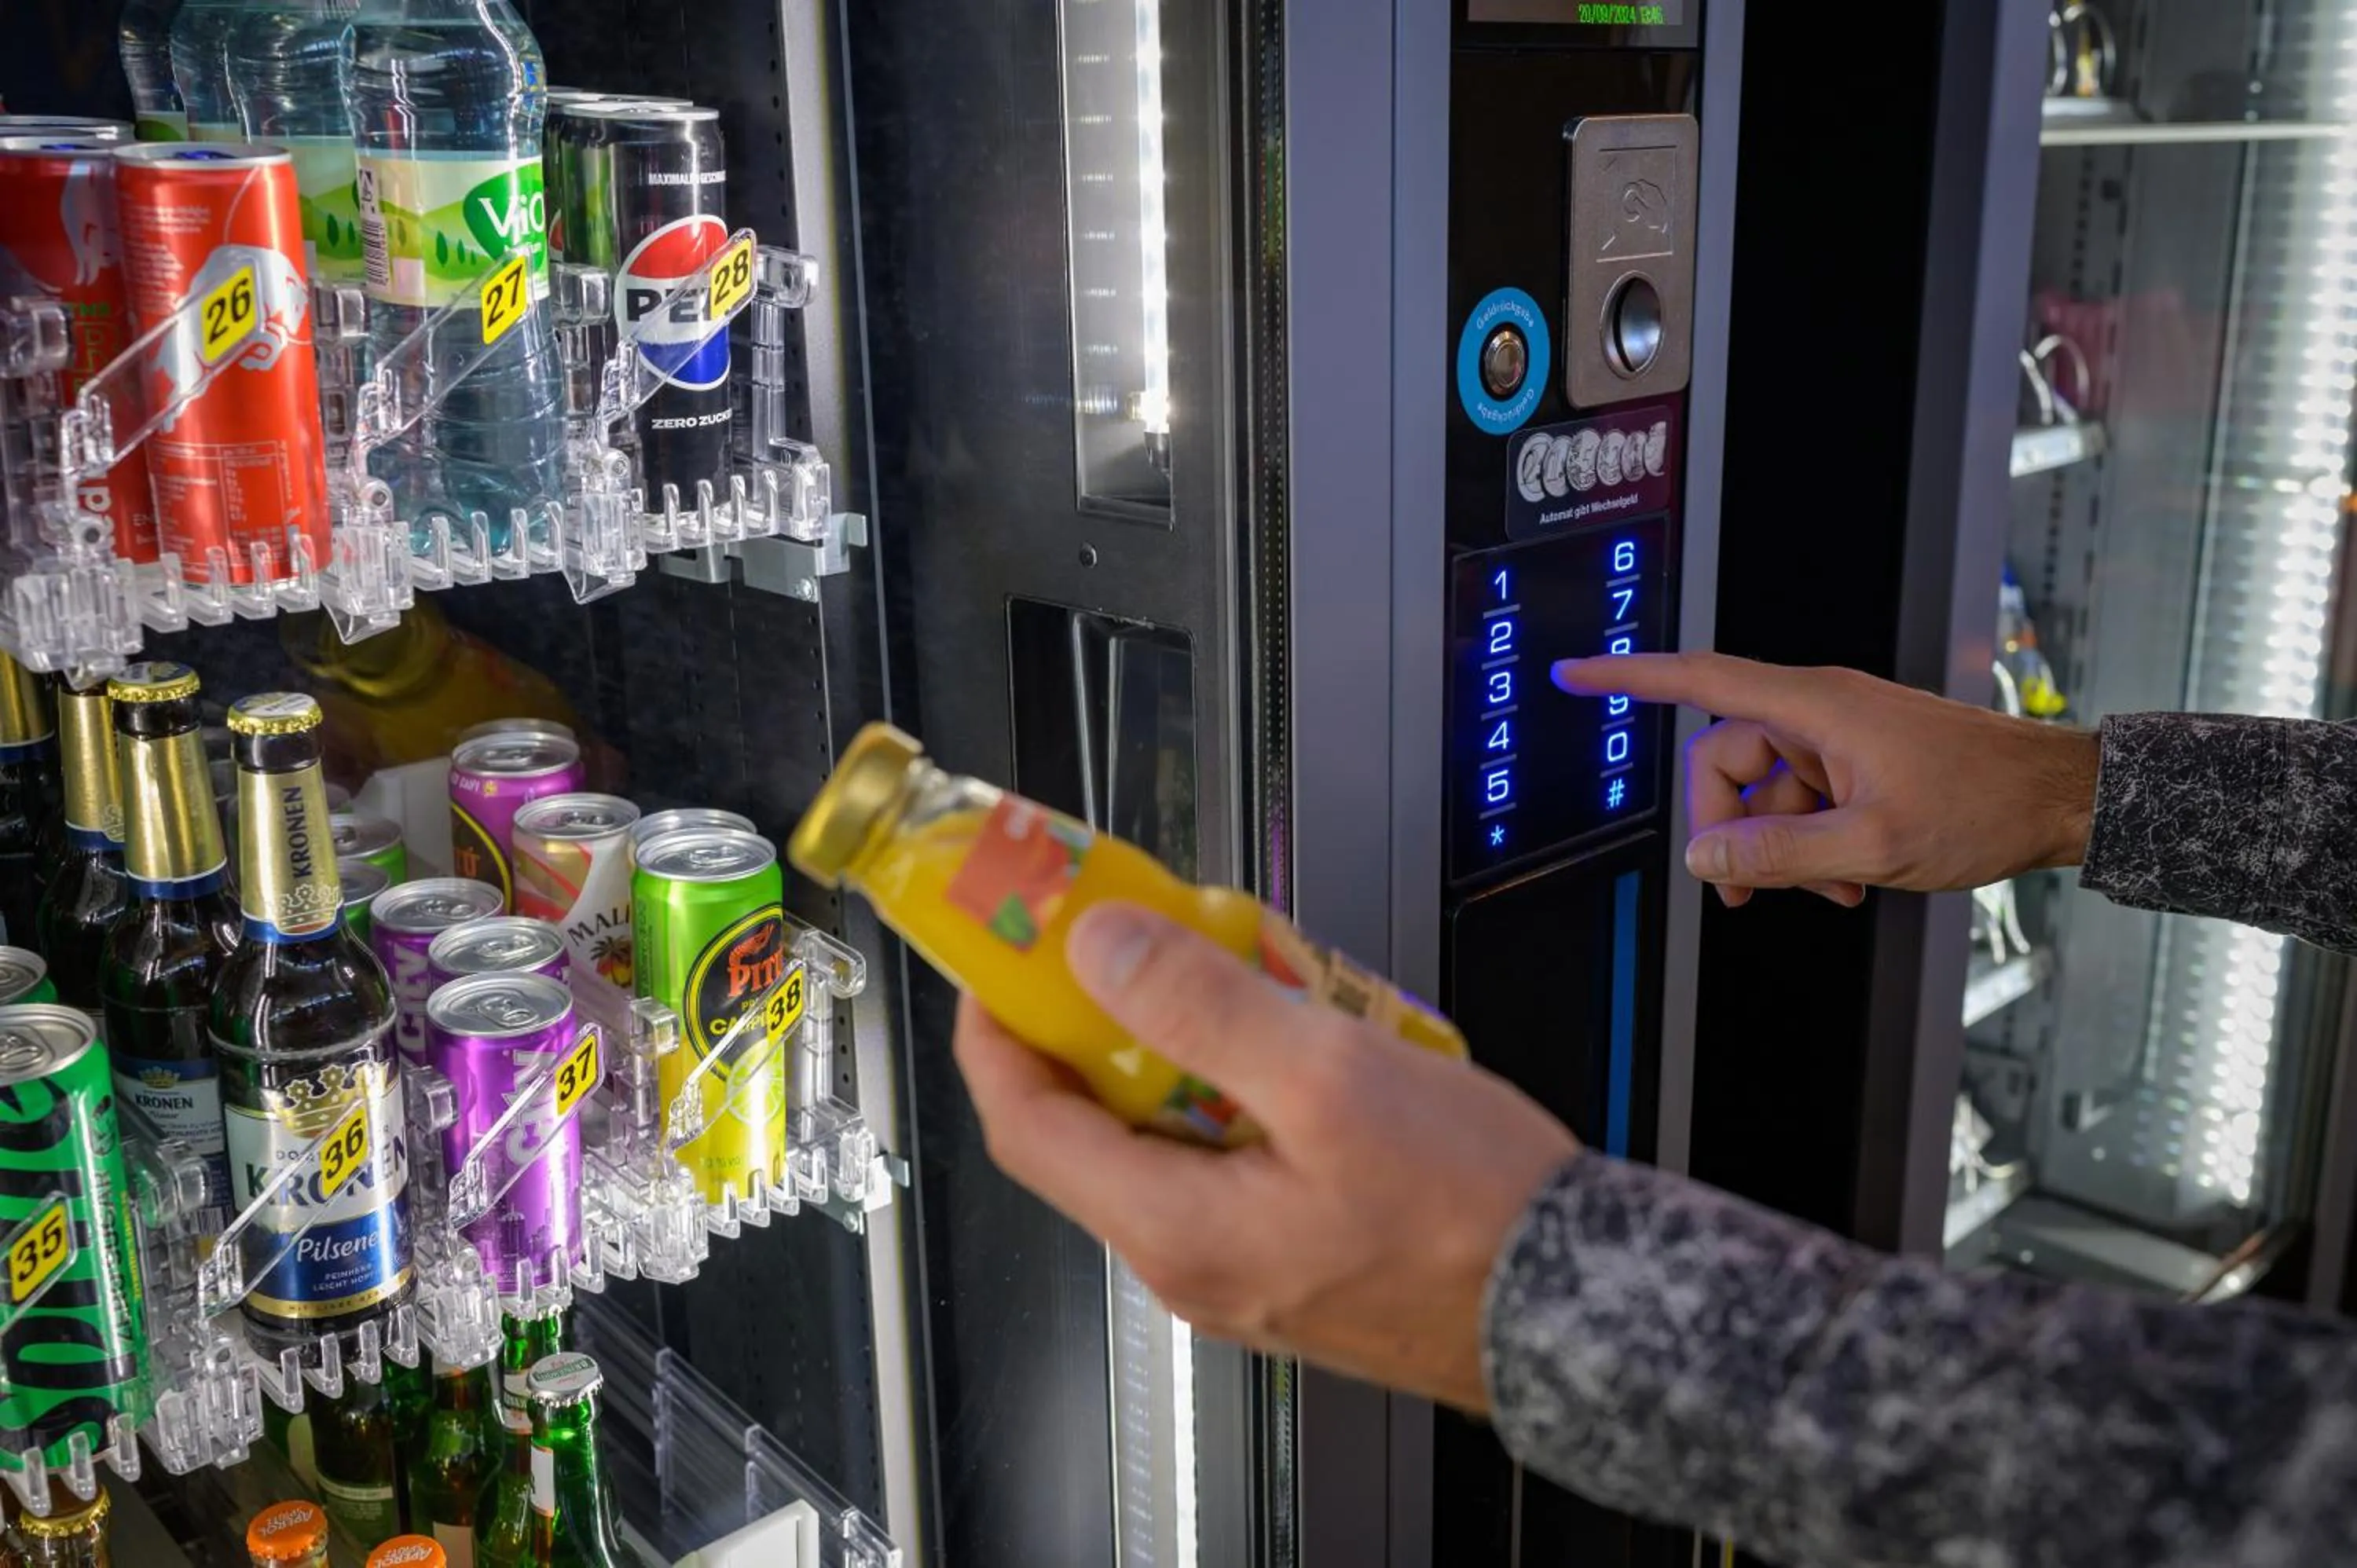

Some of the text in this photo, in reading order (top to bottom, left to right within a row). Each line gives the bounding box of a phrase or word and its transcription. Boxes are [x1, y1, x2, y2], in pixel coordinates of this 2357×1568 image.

[714, 249, 749, 306] 28
[206, 277, 252, 343] 26
[486, 263, 523, 328] 27
[651, 417, 698, 430] ZERO
[1539, 493, 1638, 525] Automat gibt Wechselgeld
[1614, 541, 1634, 572] 6
[1494, 570, 1507, 599] 1
[1612, 589, 1633, 620] 7
[1490, 621, 1512, 653] 2
[1489, 671, 1511, 703] 3
[1487, 720, 1509, 750] 4
[1607, 731, 1627, 762] 0
[1486, 769, 1508, 802] 5
[284, 786, 312, 881] KRONEN
[770, 978, 801, 1031] 38
[559, 1042, 593, 1102] 37
[134, 1093, 194, 1110] KRONEN
[324, 1118, 364, 1180] 36
[245, 1135, 406, 1207] KRONN
[17, 1214, 62, 1282] 35
[296, 1231, 379, 1263] Pilsene
